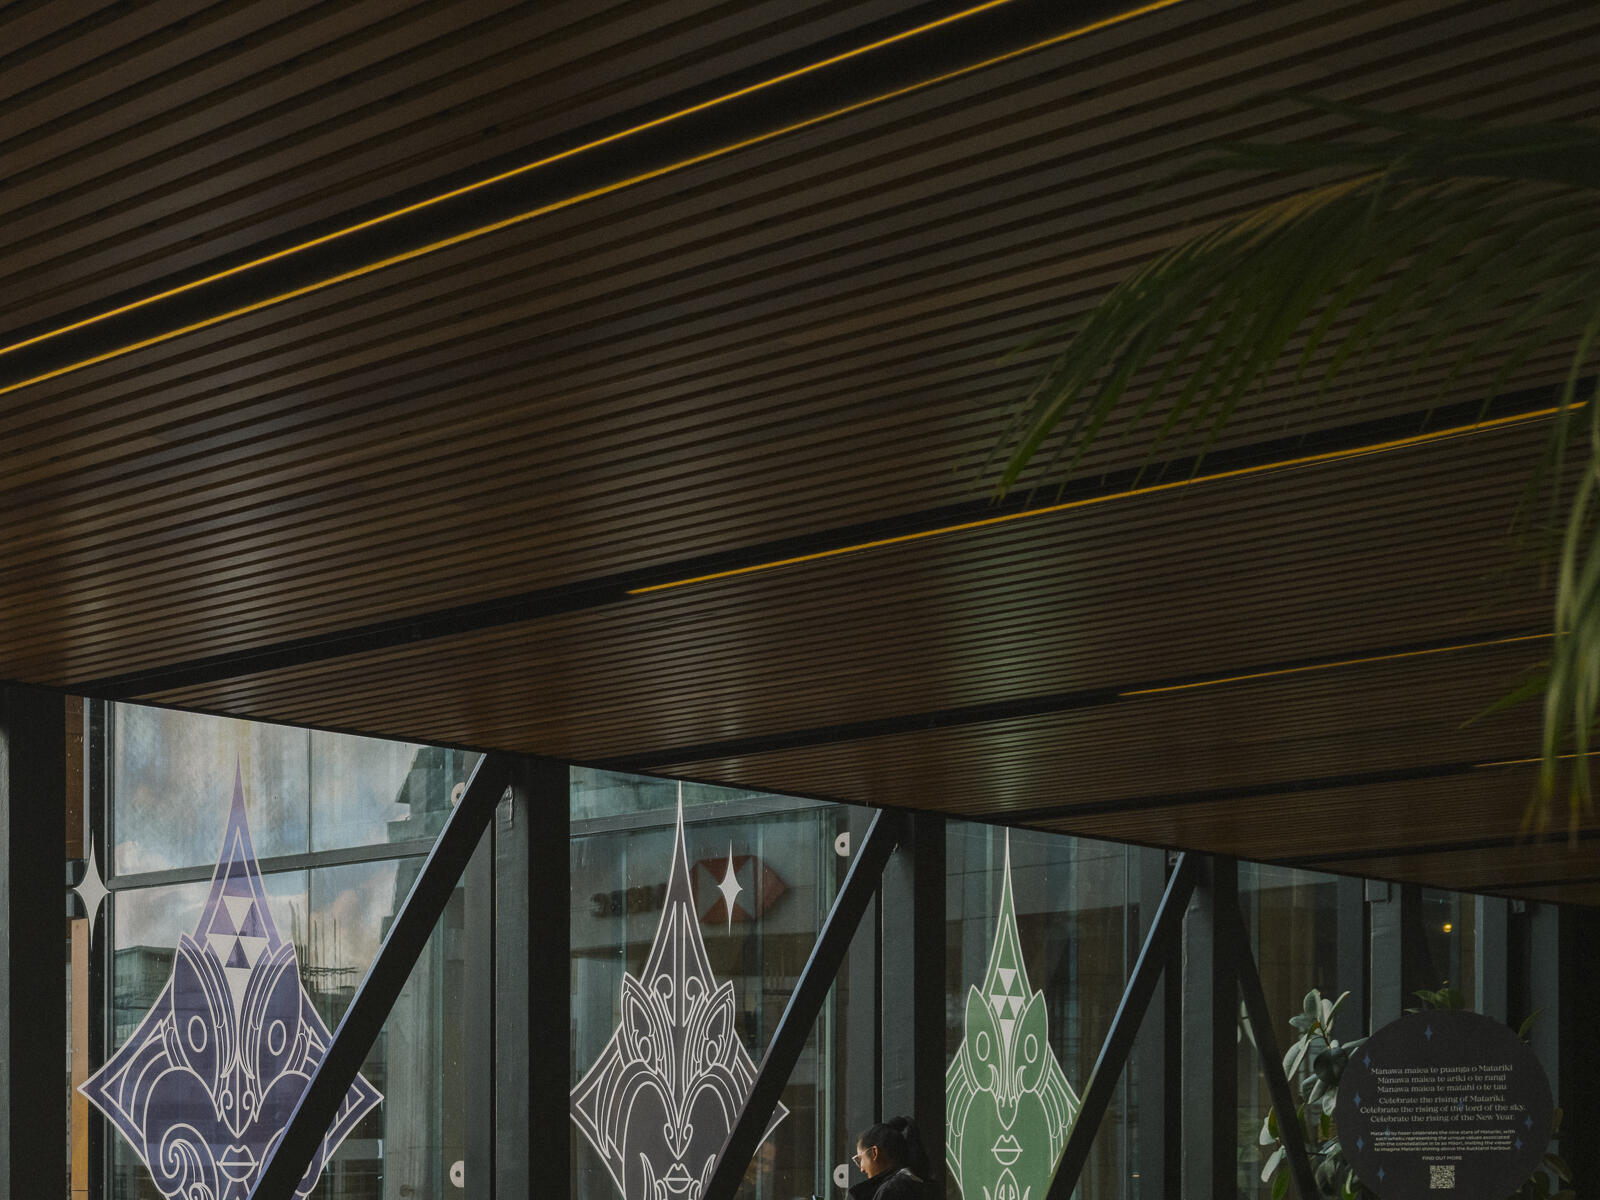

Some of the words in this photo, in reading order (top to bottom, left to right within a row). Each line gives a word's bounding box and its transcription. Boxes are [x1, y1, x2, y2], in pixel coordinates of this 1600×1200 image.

[1478, 1064, 1513, 1072] Matariki
[1446, 1074, 1466, 1082] ariki
[1484, 1073, 1506, 1082] rangi
[1434, 1096, 1458, 1104] rising
[1359, 1106, 1399, 1114] Celebrate
[1415, 1106, 1439, 1114] rising
[1465, 1104, 1483, 1112] lord
[1426, 1115, 1450, 1123] rising
[1476, 1113, 1494, 1121] New
